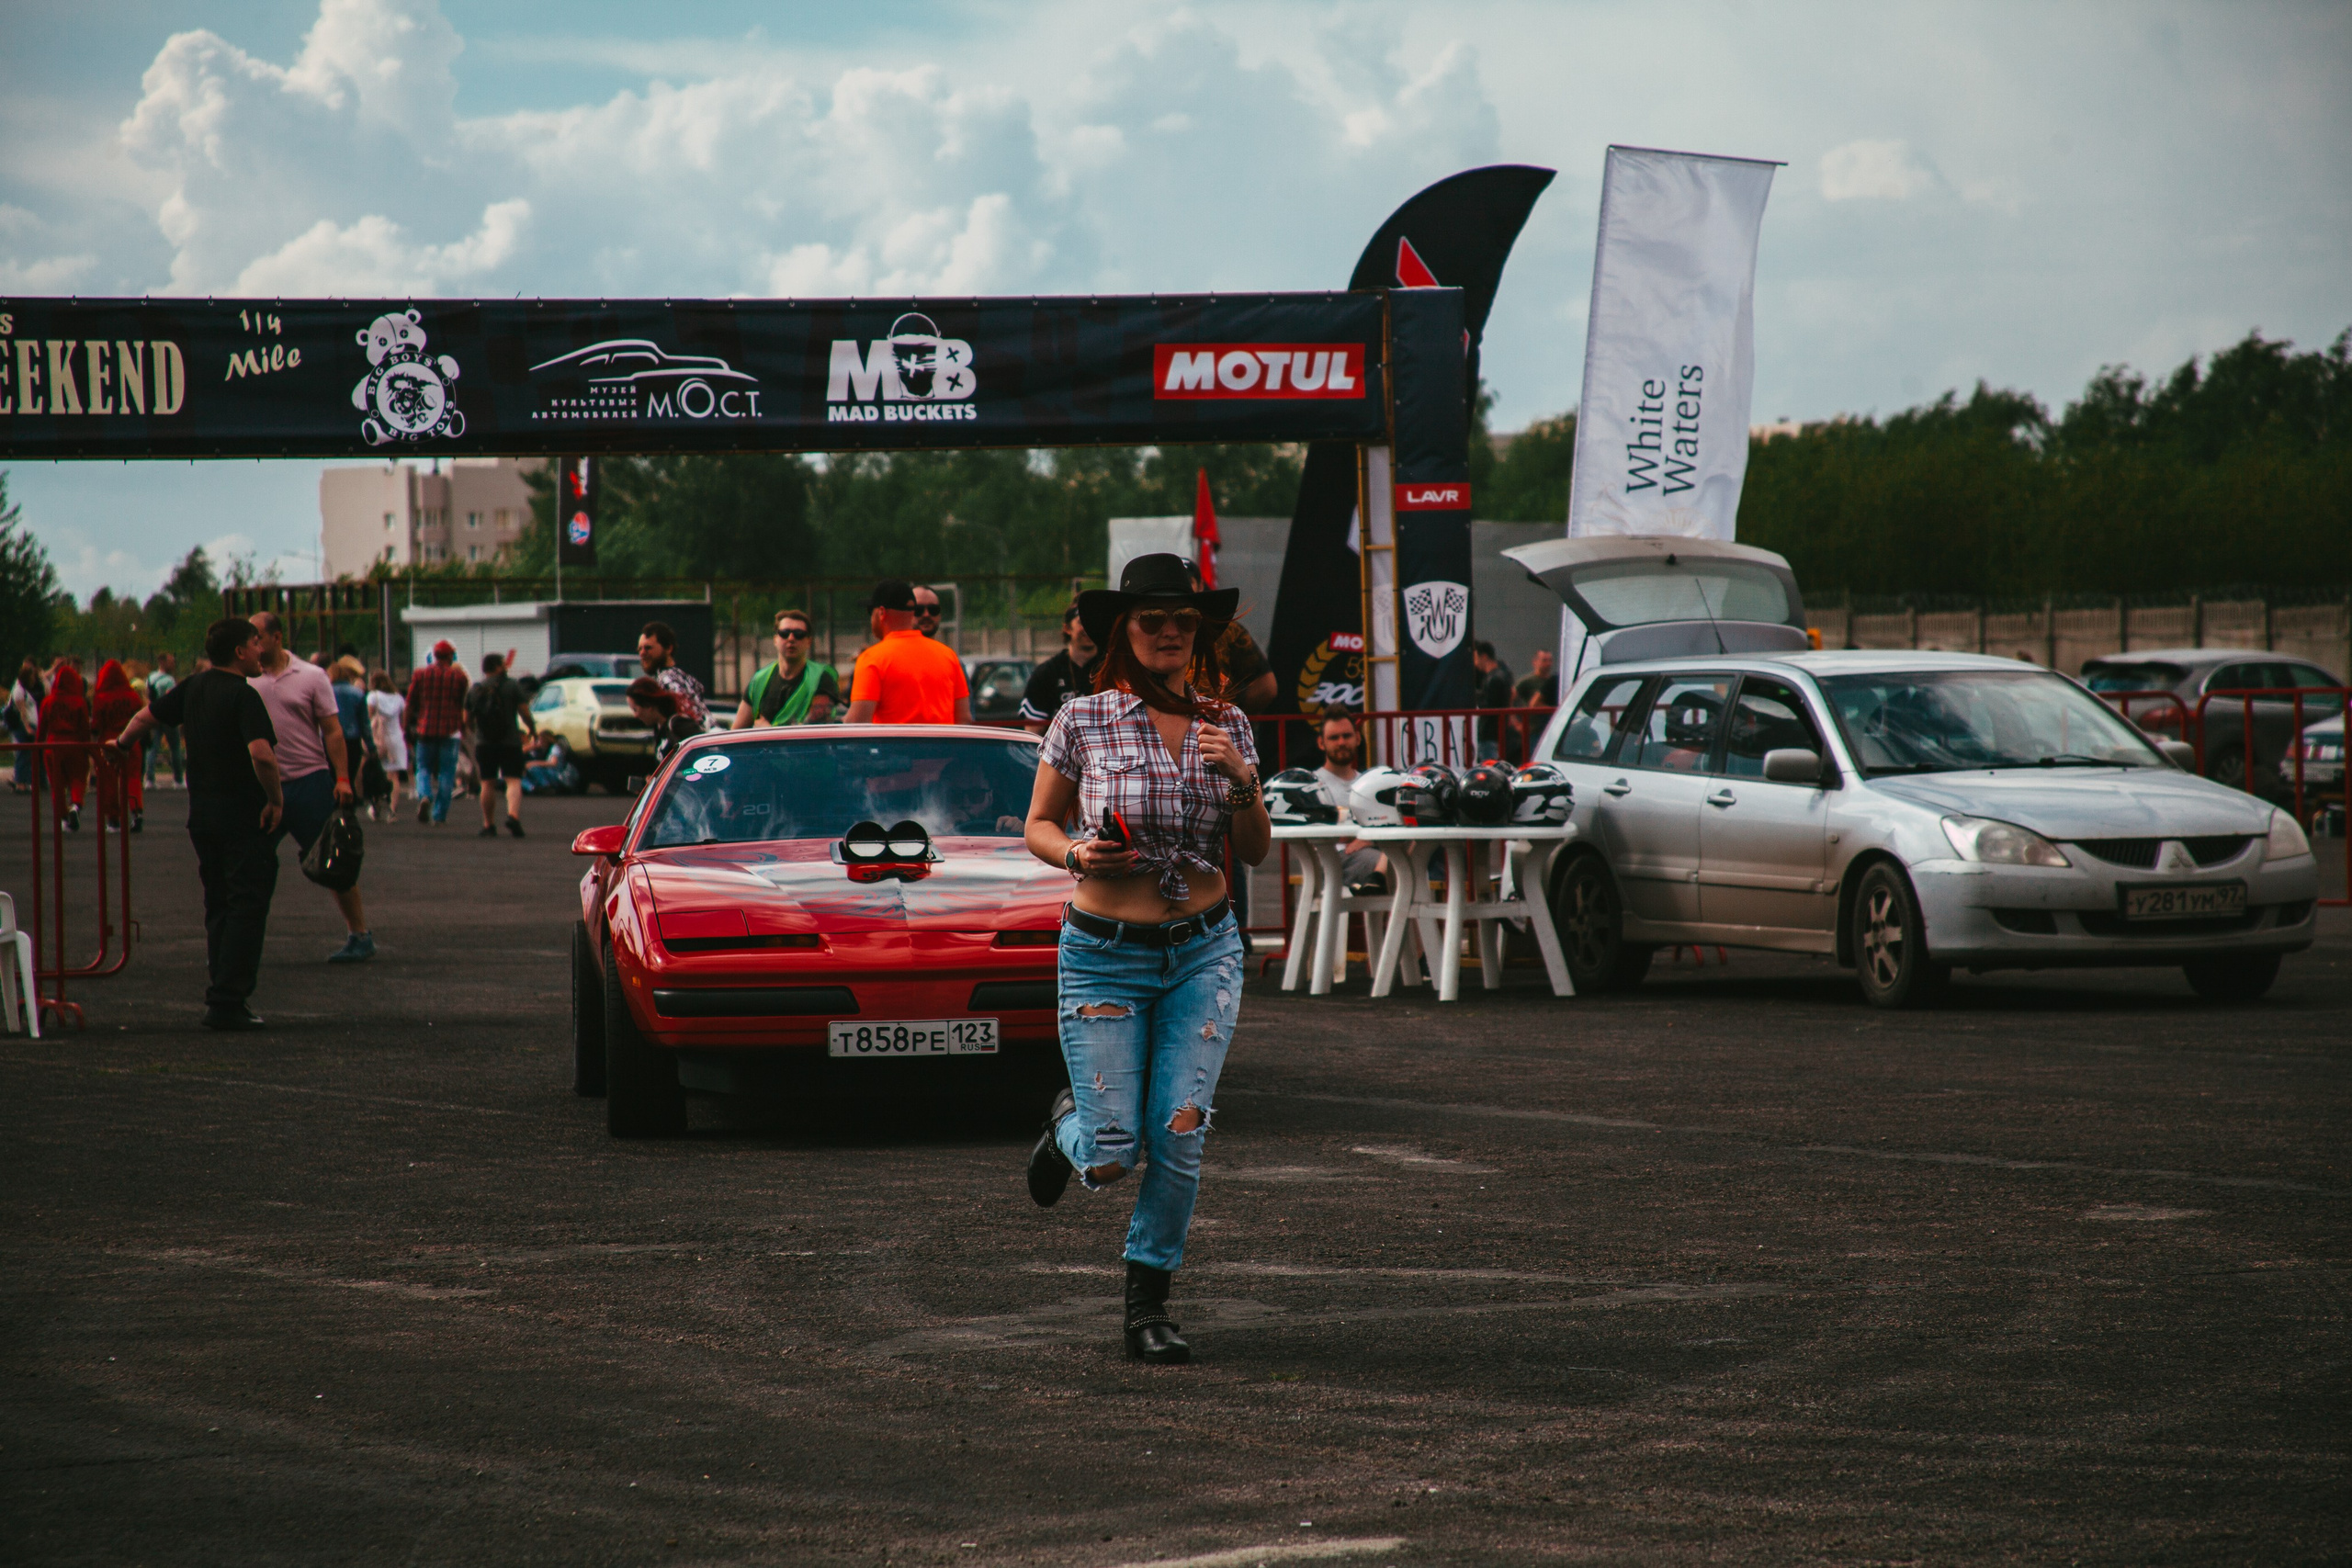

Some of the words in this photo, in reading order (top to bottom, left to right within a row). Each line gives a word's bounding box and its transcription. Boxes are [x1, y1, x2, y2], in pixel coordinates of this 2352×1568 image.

[224, 344, 302, 381] Mile
[1164, 350, 1357, 392] MOTUL
[368, 367, 384, 395] BIG
[390, 353, 433, 367] BOYS
[590, 386, 637, 394] МУЗЕЙ
[551, 399, 637, 407] КУЛЬТОВЫХ
[389, 428, 418, 441] BIG
[427, 400, 454, 437] TOYS
[532, 411, 638, 419] АВТОМОБИЛЕЙ
[829, 405, 879, 422] MAD
[884, 404, 978, 421] BUCKETS
[1626, 378, 1667, 493] White
[1663, 365, 1704, 497] Waters
[1407, 490, 1459, 503] LAVR
[707, 758, 719, 767] 7
[952, 1023, 992, 1043] 123
[960, 1043, 980, 1052] RUS
